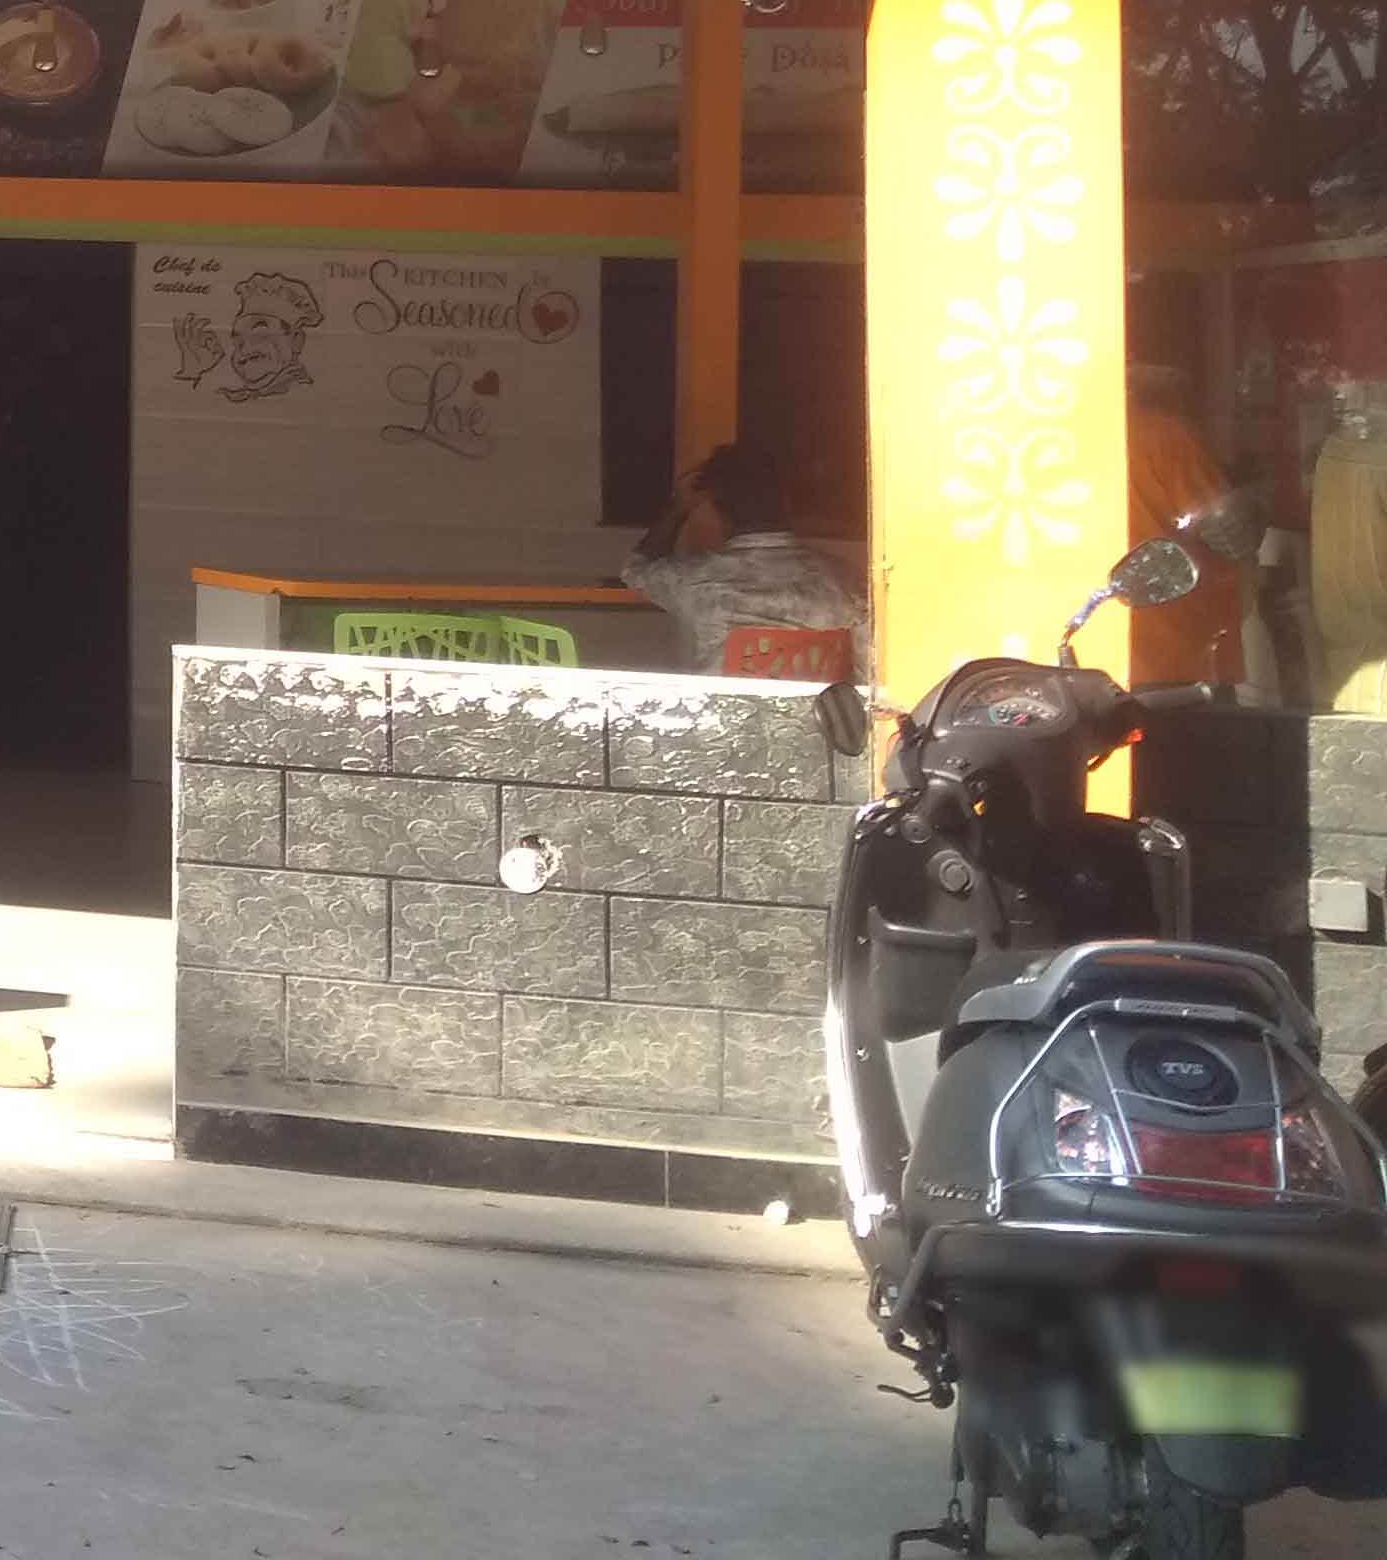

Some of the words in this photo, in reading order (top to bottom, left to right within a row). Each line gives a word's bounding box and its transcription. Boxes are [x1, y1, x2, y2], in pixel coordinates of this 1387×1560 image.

[152, 255, 196, 276] Chef
[200, 259, 222, 274] de
[153, 280, 213, 297] cuisine
[403, 267, 508, 290] KITCHEN
[354, 258, 579, 344] Seasoned
[379, 361, 497, 460] Love
[1161, 1061, 1204, 1076] TVS
